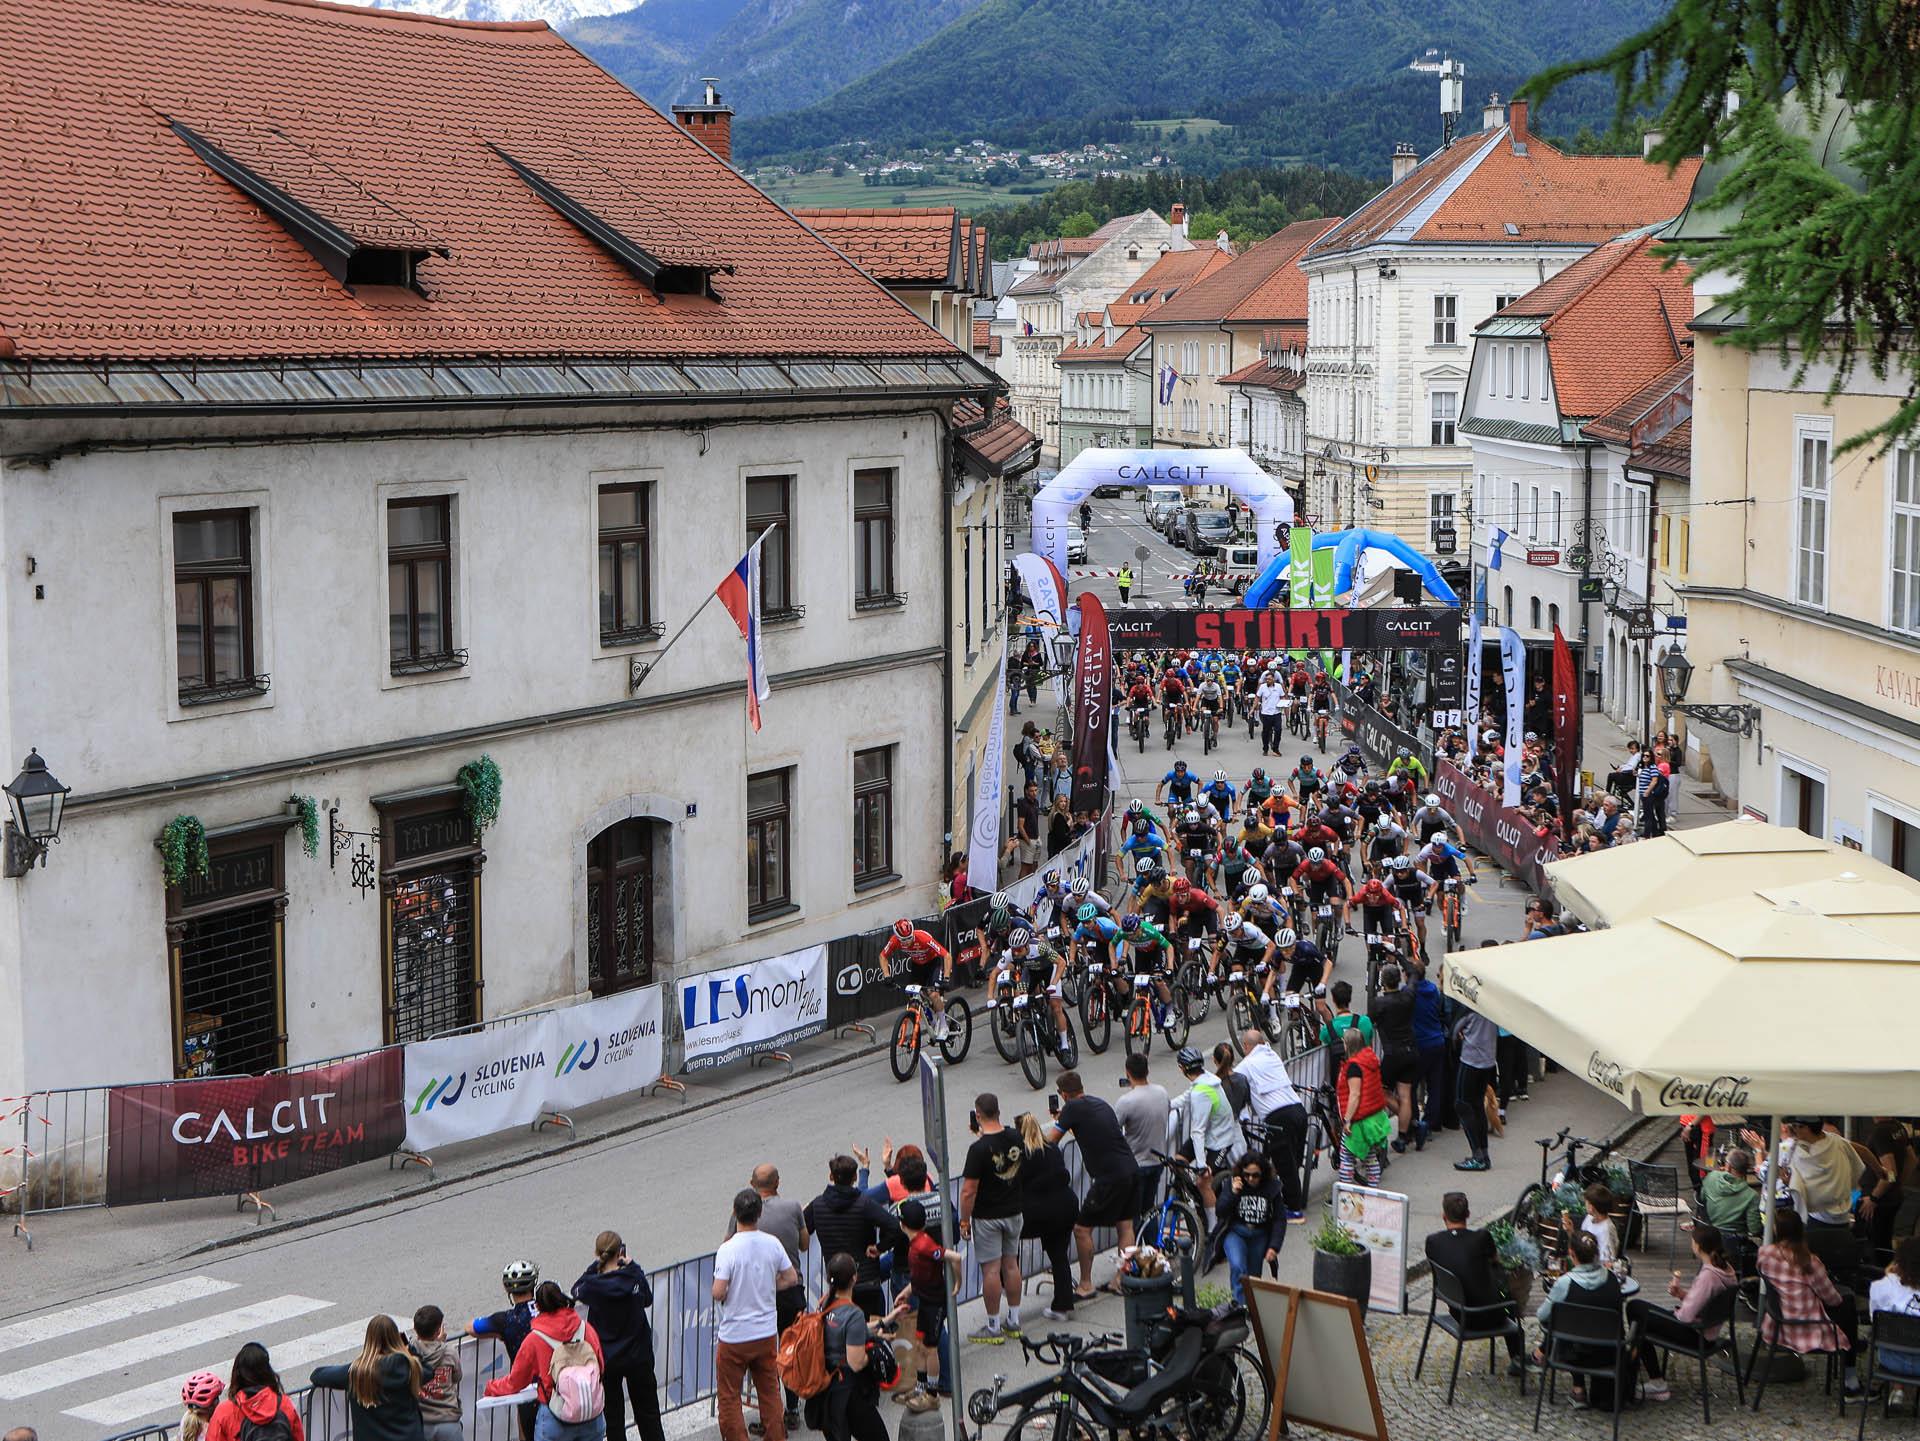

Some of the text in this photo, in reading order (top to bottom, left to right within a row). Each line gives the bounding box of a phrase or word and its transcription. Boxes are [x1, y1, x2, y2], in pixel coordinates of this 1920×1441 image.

[1118, 465, 1209, 480] CALCIT
[1046, 516, 1055, 560] ALCIT
[1108, 622, 1153, 632] CALCIT
[1195, 610, 1350, 649] START
[1385, 621, 1432, 631] CALCIT
[1436, 713, 1458, 724] 6 7
[403, 818, 462, 853] TATTOO
[608, 1020, 656, 1049] SLOVENIA
[604, 1044, 634, 1065] CYCLING
[744, 1045, 752, 1055] in
[474, 1051, 546, 1082] SLOVENIA
[471, 1077, 516, 1099] CYCLING
[1660, 1076, 1753, 1108] Coca-Cola
[171, 1092, 337, 1144] CALCIT
[233, 1122, 365, 1167] BIKE TEAM
